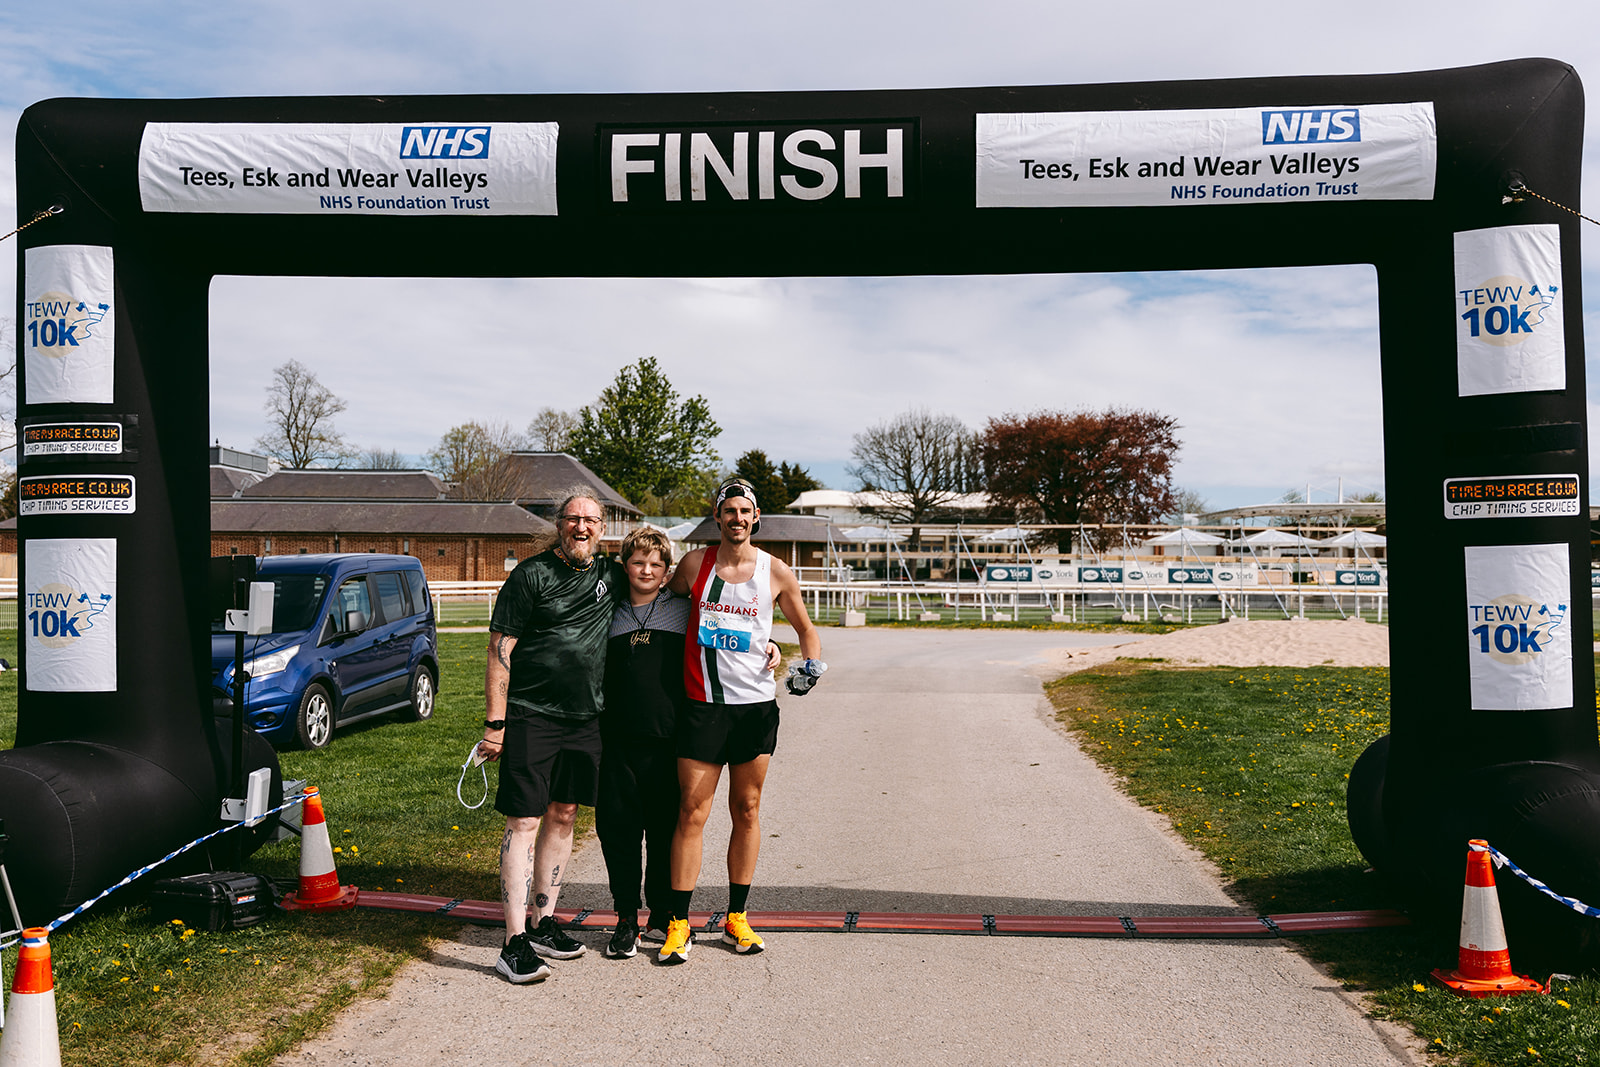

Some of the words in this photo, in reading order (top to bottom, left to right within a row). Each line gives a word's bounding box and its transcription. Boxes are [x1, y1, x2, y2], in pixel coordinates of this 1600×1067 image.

[1265, 111, 1356, 142] NHS
[402, 128, 488, 157] NHS
[611, 129, 903, 202] FINISH
[1020, 159, 1080, 181] Tees,
[1089, 157, 1129, 179] Esk
[1138, 156, 1184, 178] and
[1194, 156, 1261, 176] Wear
[1270, 152, 1360, 179] Valleys
[180, 167, 235, 189] Tees,
[242, 168, 280, 188] Esk
[287, 168, 330, 188] and
[337, 169, 398, 188] Wear
[405, 168, 488, 193] Valleys
[1170, 185, 1207, 199] NHS
[1212, 183, 1310, 199] Foundation
[1316, 182, 1358, 196] Trust
[319, 195, 352, 209] NHS
[357, 196, 447, 210] Foundation
[450, 196, 490, 210] Trust
[1460, 286, 1522, 306] TEWV
[27, 301, 70, 318] TEWV
[1461, 304, 1533, 337] 10k
[28, 318, 80, 347] 10k
[42, 443, 68, 452] TIMING
[70, 443, 118, 452] SERVICES
[22, 502, 35, 512] CHIP
[38, 500, 67, 511] TIMING
[71, 500, 129, 510] SERVICES
[1453, 504, 1481, 516] CHIP
[1486, 503, 1526, 514] TIMING
[1530, 501, 1576, 514] SERVICES
[1009, 568, 1029, 578] York
[1055, 570, 1074, 578] York
[1145, 570, 1164, 579] York
[1190, 570, 1209, 580] York
[1357, 572, 1376, 582] York
[27, 593, 72, 608] TEWV
[700, 601, 758, 617] PHOBIANS
[1470, 604, 1532, 622] TEWV
[28, 610, 81, 637] 10k
[704, 620, 719, 628] 10k
[710, 633, 738, 650] 116
[1472, 623, 1542, 653] 10k
